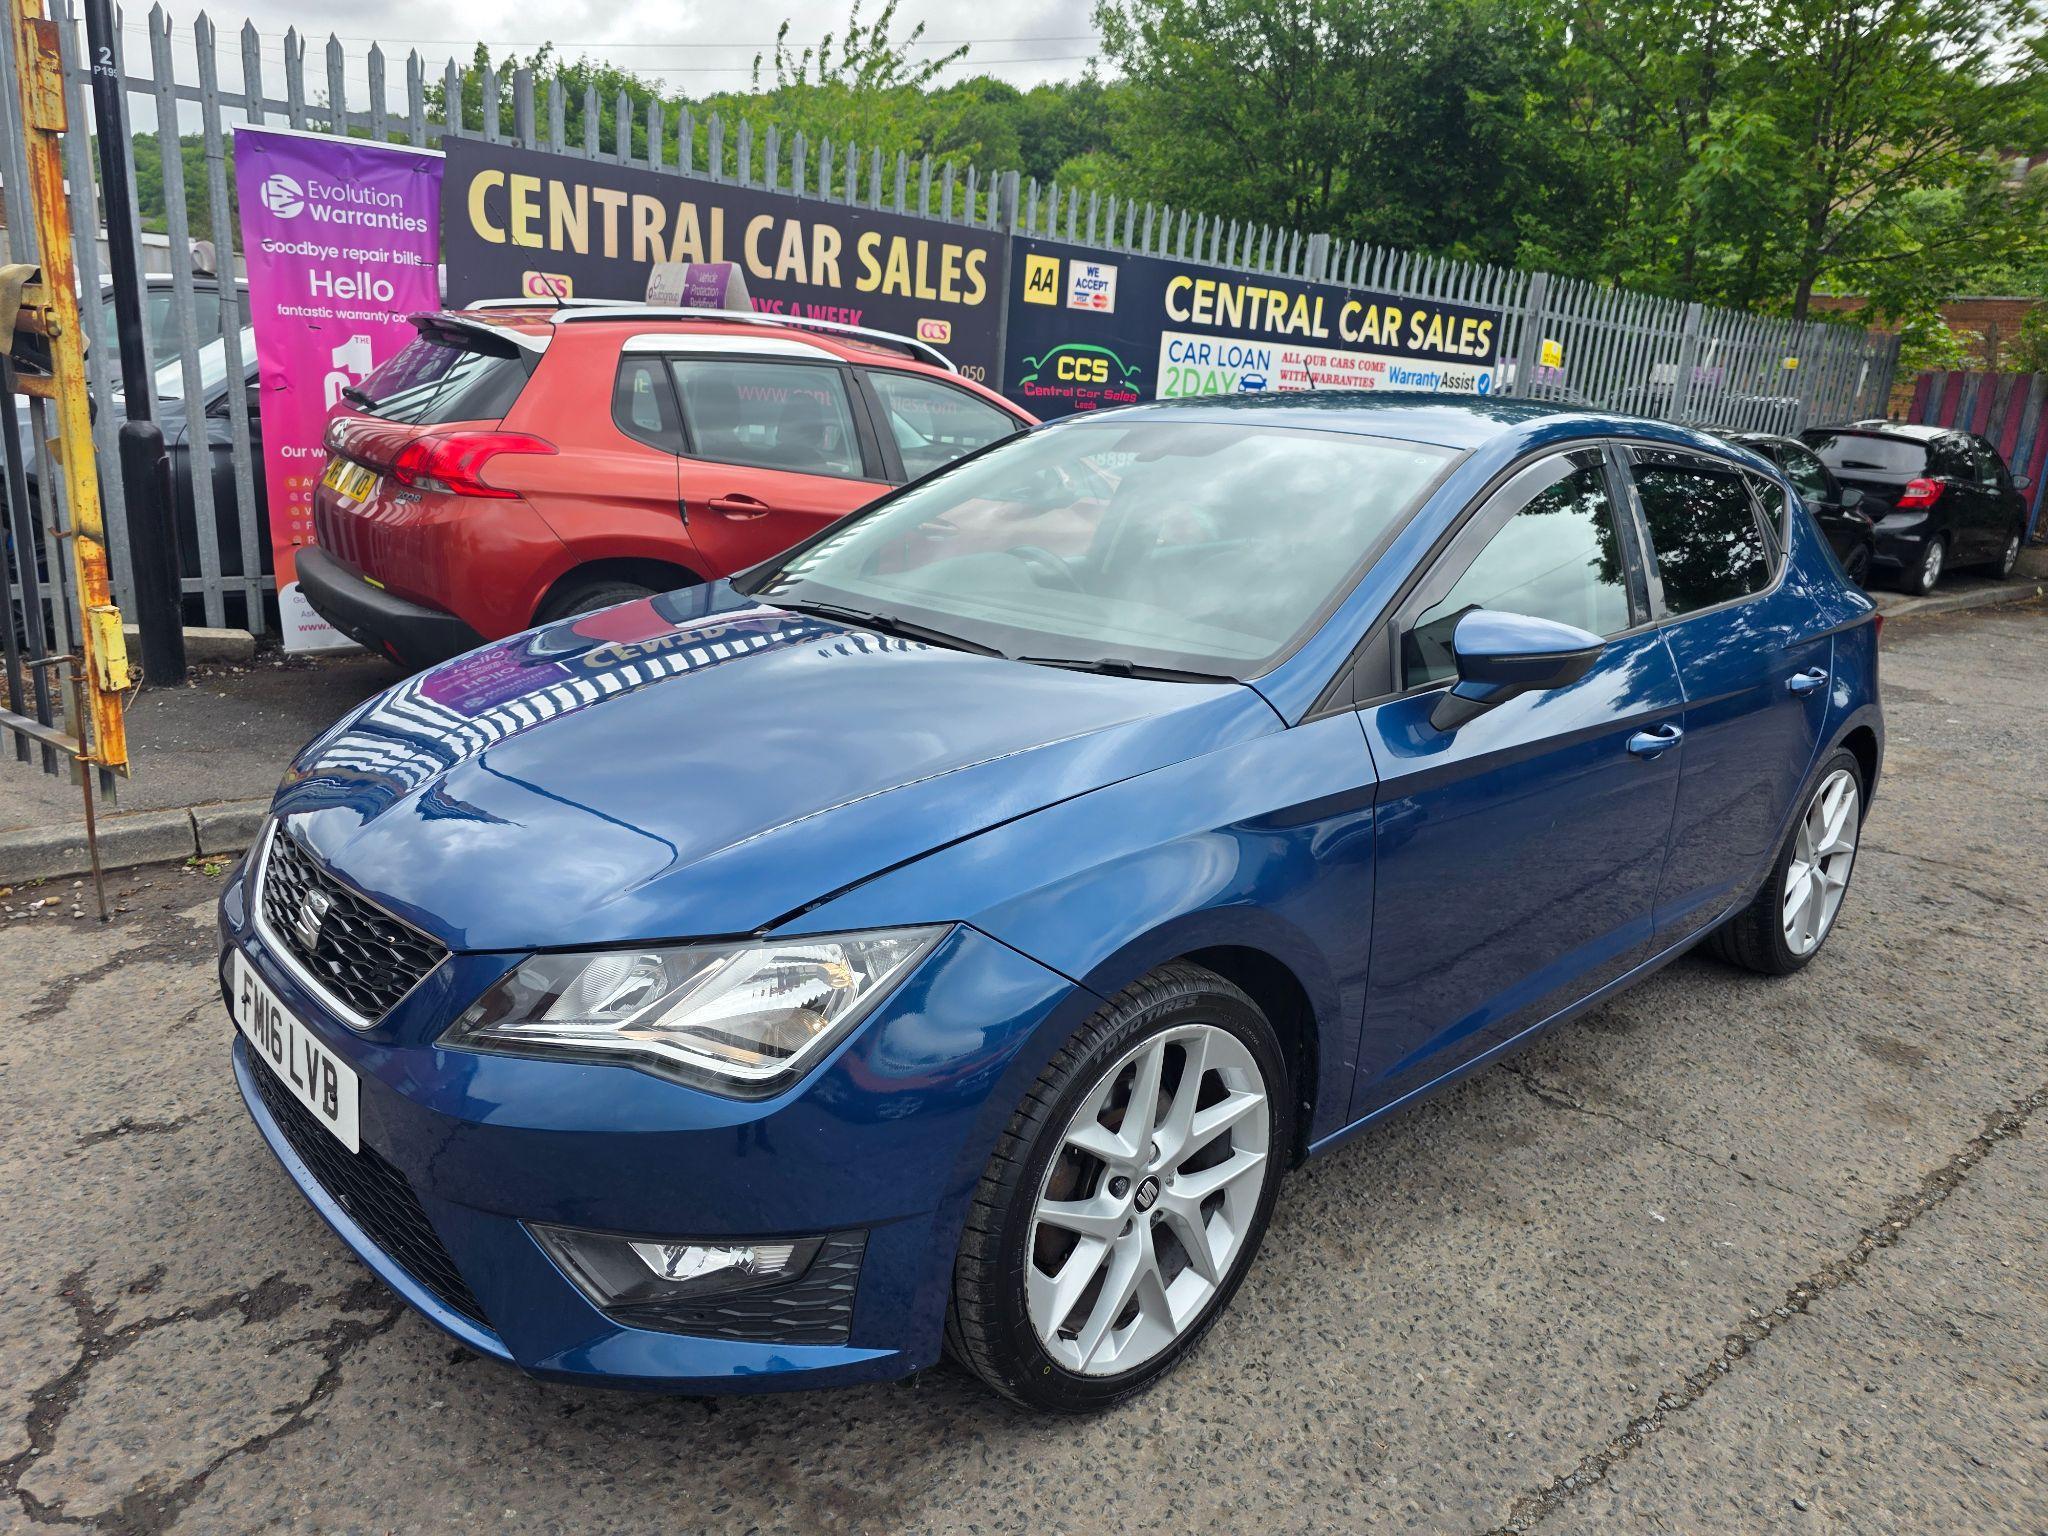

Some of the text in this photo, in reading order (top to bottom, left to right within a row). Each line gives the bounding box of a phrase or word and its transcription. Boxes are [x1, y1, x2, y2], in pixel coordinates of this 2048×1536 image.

[98, 46, 113, 66] 2
[307, 180, 404, 208] Evolution
[308, 203, 428, 233] Warranties
[261, 238, 339, 261] Goodbye
[342, 247, 390, 264] repair
[467, 169, 987, 306] CENTRAL CAR SALES
[308, 268, 395, 302] Hello
[1028, 266, 1054, 293] AA
[1075, 277, 1109, 292] ACCEPT
[1086, 265, 1100, 278] WE
[277, 303, 408, 325] fantastic warranty co
[806, 303, 863, 333] WEEK
[1164, 275, 1493, 358] CENTRAL CAR SALES
[1168, 339, 1271, 371] CAR LOAN
[1281, 352, 1386, 373] ALL OUR CARS COME
[1056, 355, 1109, 384] CCS
[1164, 366, 1237, 397] 2DAY
[1279, 369, 1375, 388] WITH WARRANTIES
[1024, 381, 1138, 403] Central Car Sales
[1074, 399, 1097, 410] Leeds
[281, 445, 307, 458] Our
[243, 969, 339, 1122] FM16 LVB
